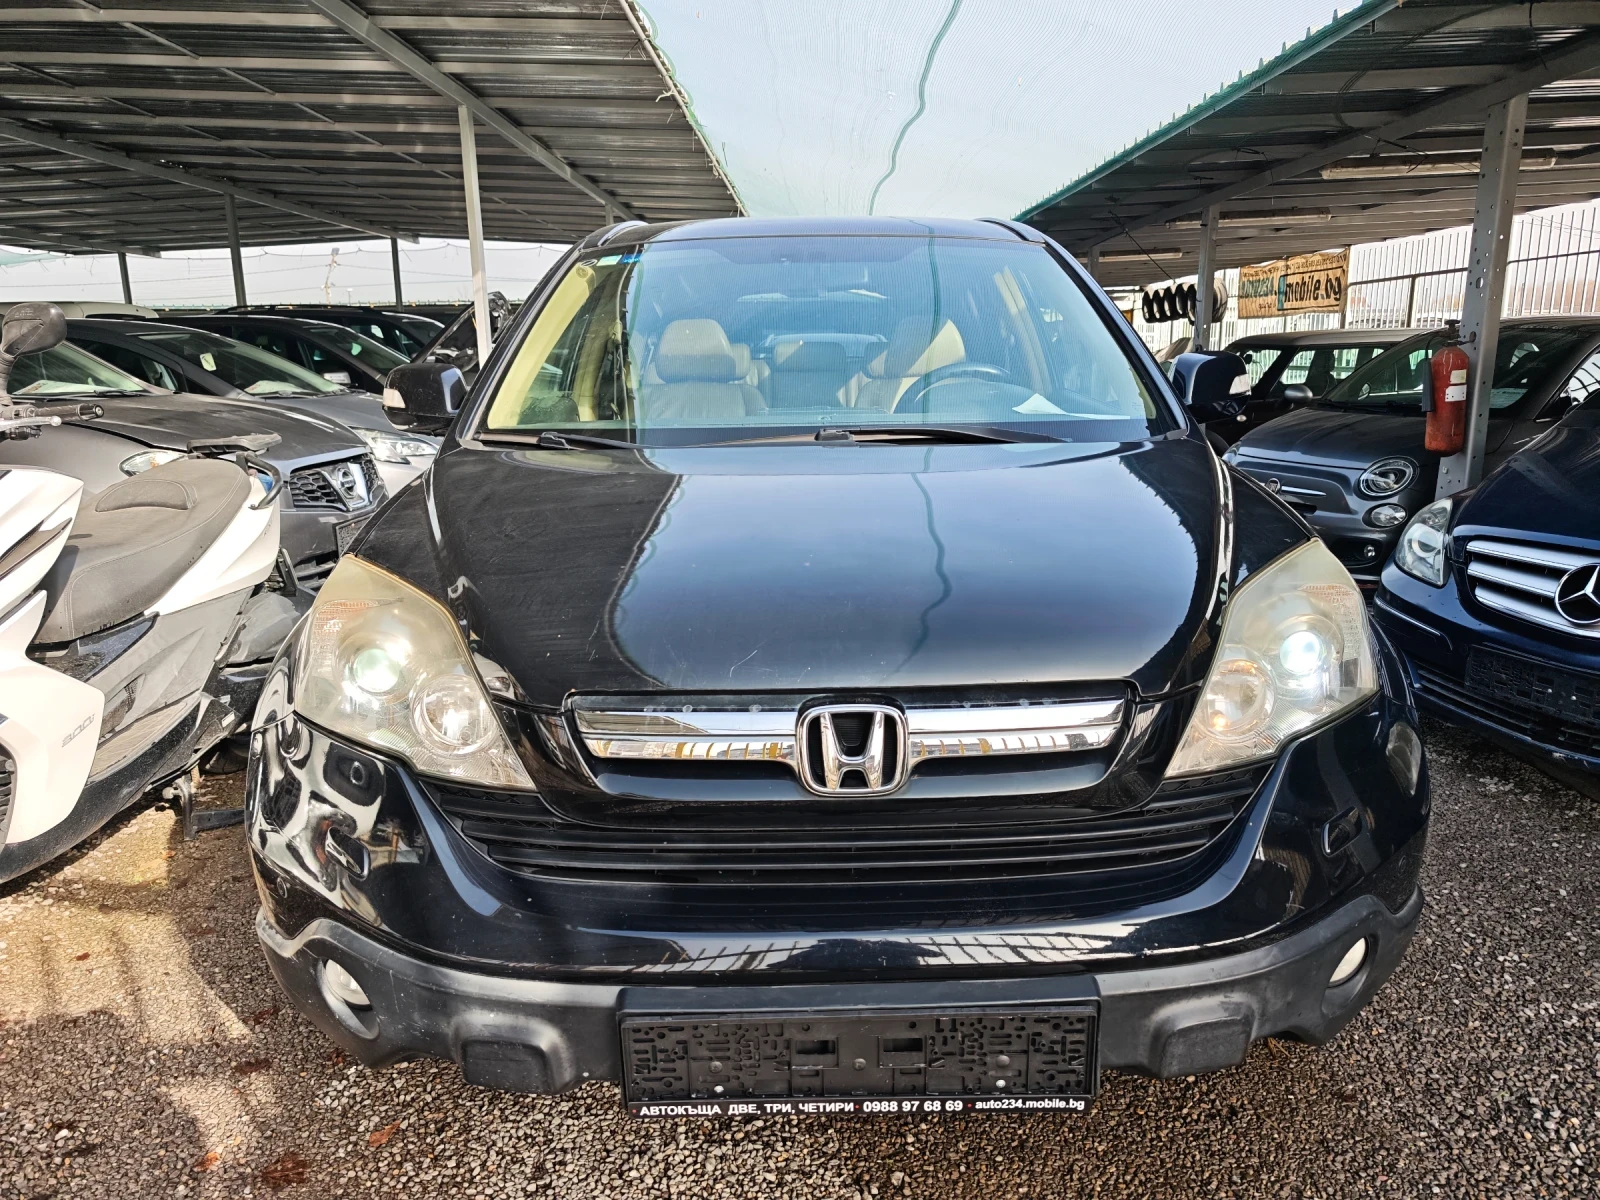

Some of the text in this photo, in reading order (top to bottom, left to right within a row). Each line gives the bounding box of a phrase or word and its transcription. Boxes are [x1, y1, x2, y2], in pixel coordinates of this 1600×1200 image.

[1284, 272, 1342, 302] mobile.bg
[639, 1098, 1085, 1116] АВТОКЪЩА ДВЕ, ТРИ, ЧЕТИРИ 0988 97 68 69 auto234.mobile.bg
